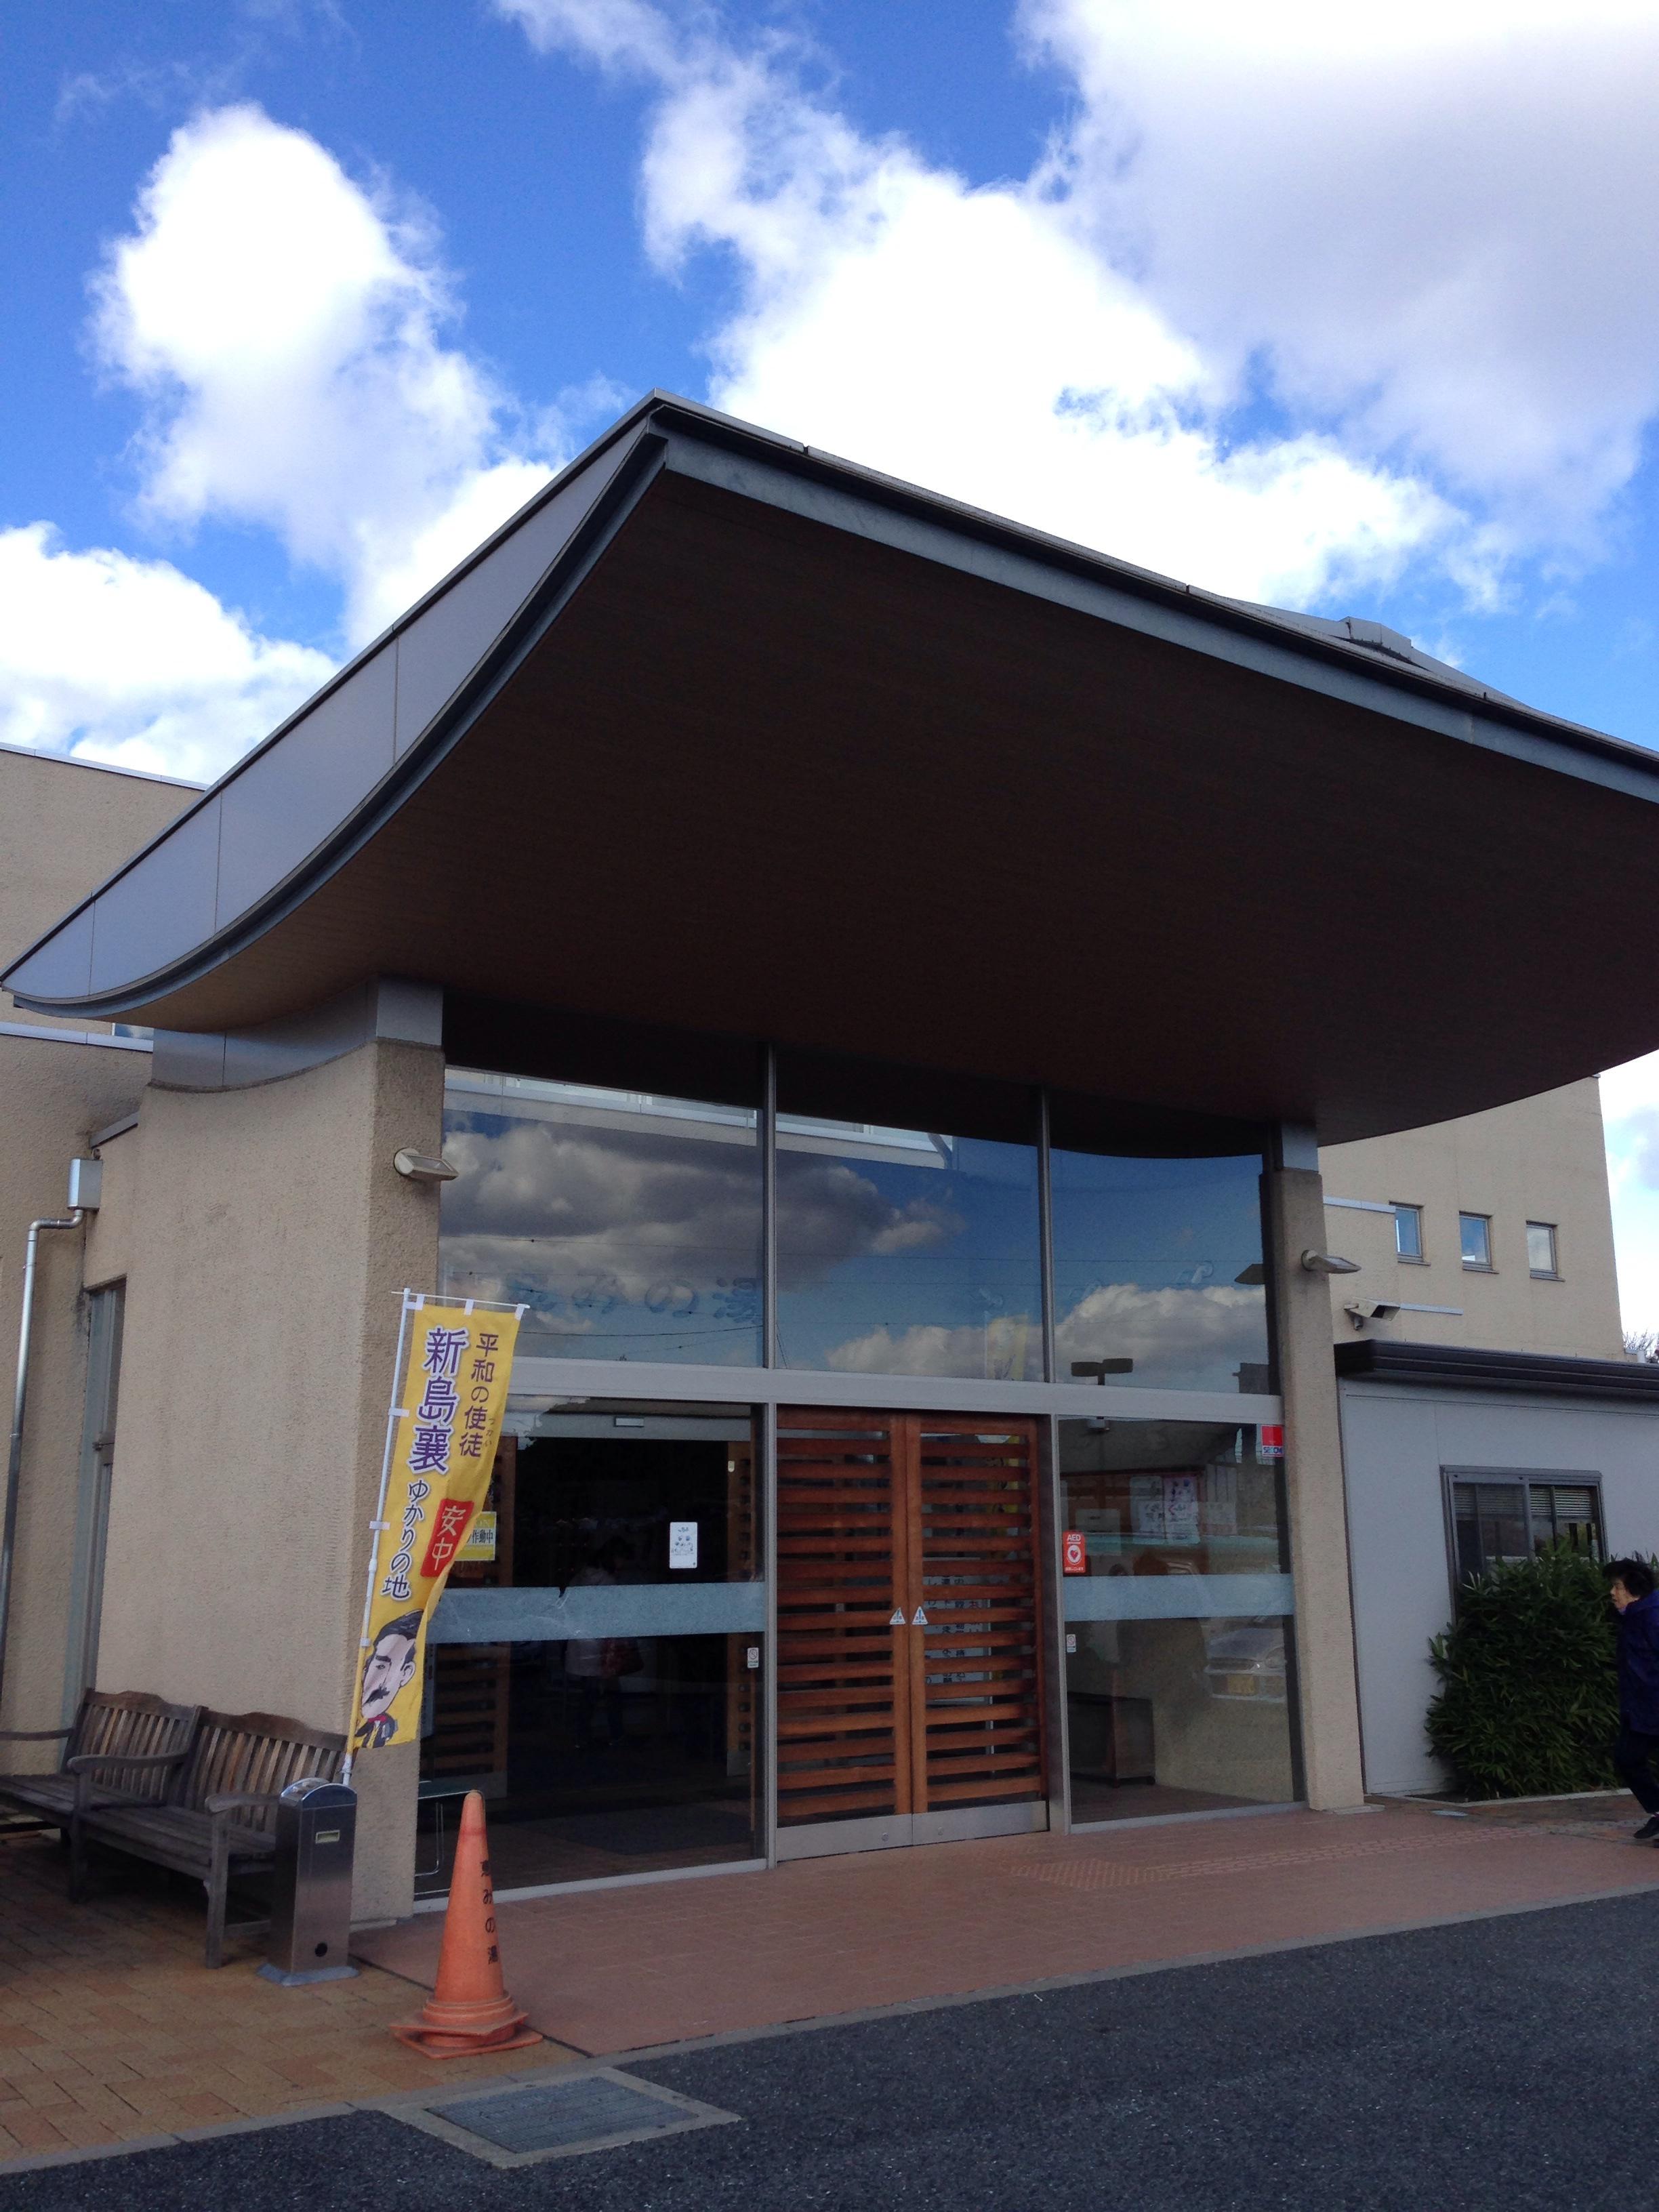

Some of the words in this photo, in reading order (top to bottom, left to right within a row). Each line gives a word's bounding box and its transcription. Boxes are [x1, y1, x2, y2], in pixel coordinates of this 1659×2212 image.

[408, 1327, 467, 1472] 新島襄
[459, 1333, 499, 1457] 平和の使徒
[382, 1479, 428, 1599] ゆかりの地
[432, 1505, 466, 1571] 安中
[466, 1529, 493, 1544] 作動中
